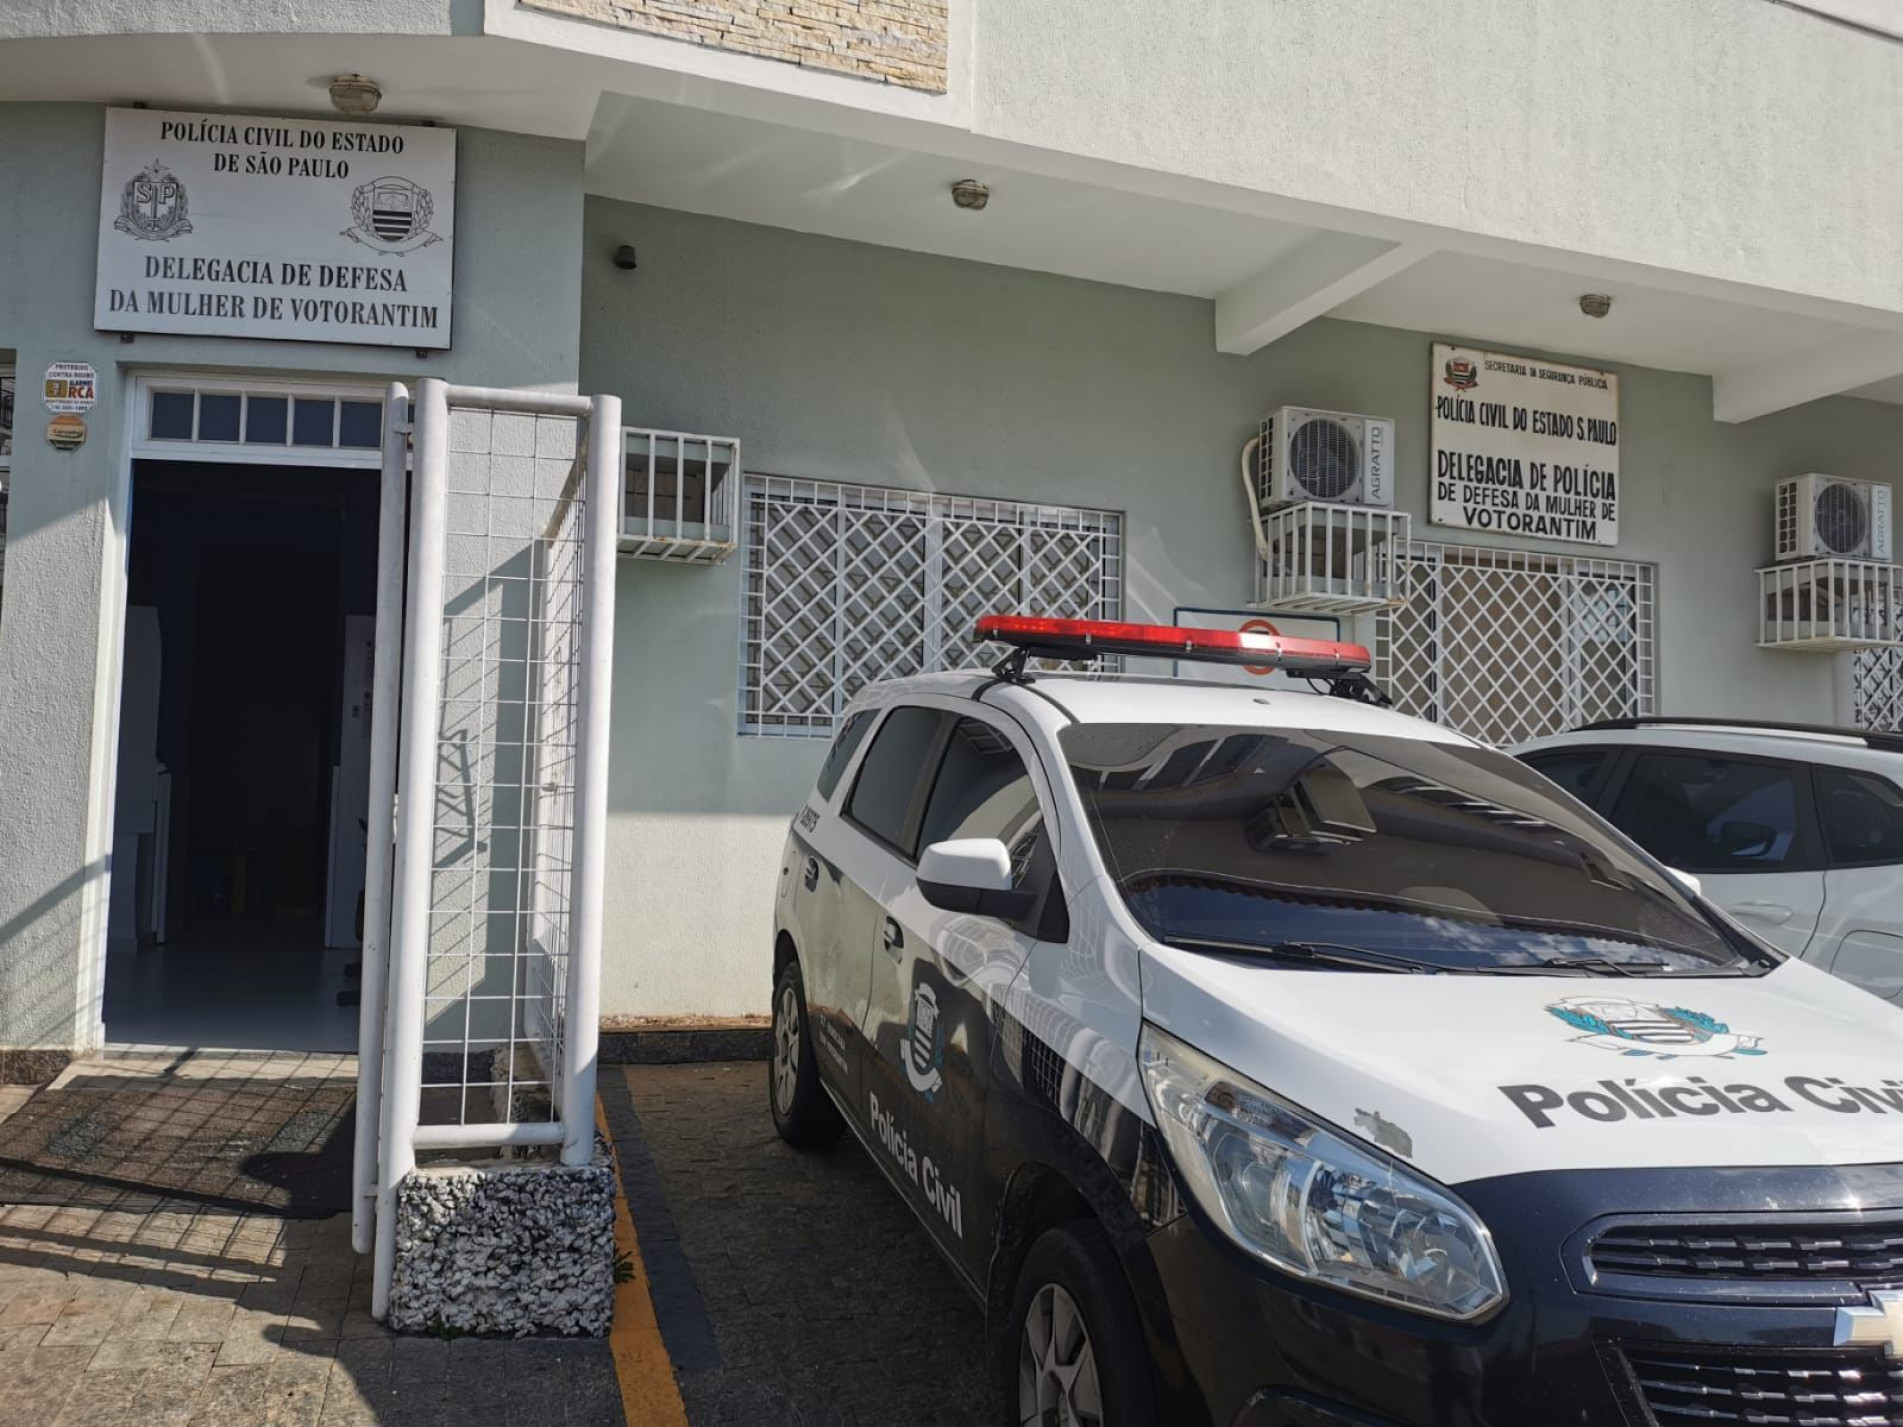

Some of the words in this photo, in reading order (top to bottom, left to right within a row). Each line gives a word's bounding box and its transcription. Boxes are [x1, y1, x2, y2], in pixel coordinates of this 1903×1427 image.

[161, 119, 238, 145] POLÍCIA
[244, 126, 294, 148] CIVIL
[300, 130, 326, 150] DO
[331, 132, 404, 154] ESTADO
[214, 153, 241, 172] DE
[245, 152, 282, 175] SÃO
[288, 157, 349, 179] PAULO
[145, 255, 272, 285] DELEGACIA
[281, 263, 311, 287] DE
[319, 265, 407, 292] DEFESA
[109, 289, 139, 313] DA
[147, 291, 246, 318] MULHER
[253, 297, 283, 321] DE
[291, 299, 438, 329] VOTORANTIM
[69, 386, 94, 398] RCA
[1485, 360, 1527, 376] SECRETARIA
[1539, 369, 1576, 384] SEGURANÇA
[1437, 394, 1475, 424] POLÍCIA
[1480, 402, 1509, 429] CIVIL
[1513, 407, 1527, 431] DO
[1532, 410, 1573, 439] ESTADO
[1371, 427, 1381, 499] AGRATTO
[1438, 449, 1524, 490] DELEGACIA
[1530, 462, 1547, 492] DE
[1553, 464, 1615, 501] POLÍCIA
[1438, 481, 1456, 502] DE
[1464, 484, 1519, 510] DEFESA
[1525, 492, 1540, 512] DA
[1546, 495, 1596, 519] MULHER
[1602, 502, 1615, 522] DE
[1463, 506, 1596, 541] VOTORANTIM
[1497, 1076, 1794, 1129] Polícia
[1784, 1076, 1903, 1114] Civ
[870, 1091, 919, 1186] Polícia
[922, 1156, 963, 1240] Civil
